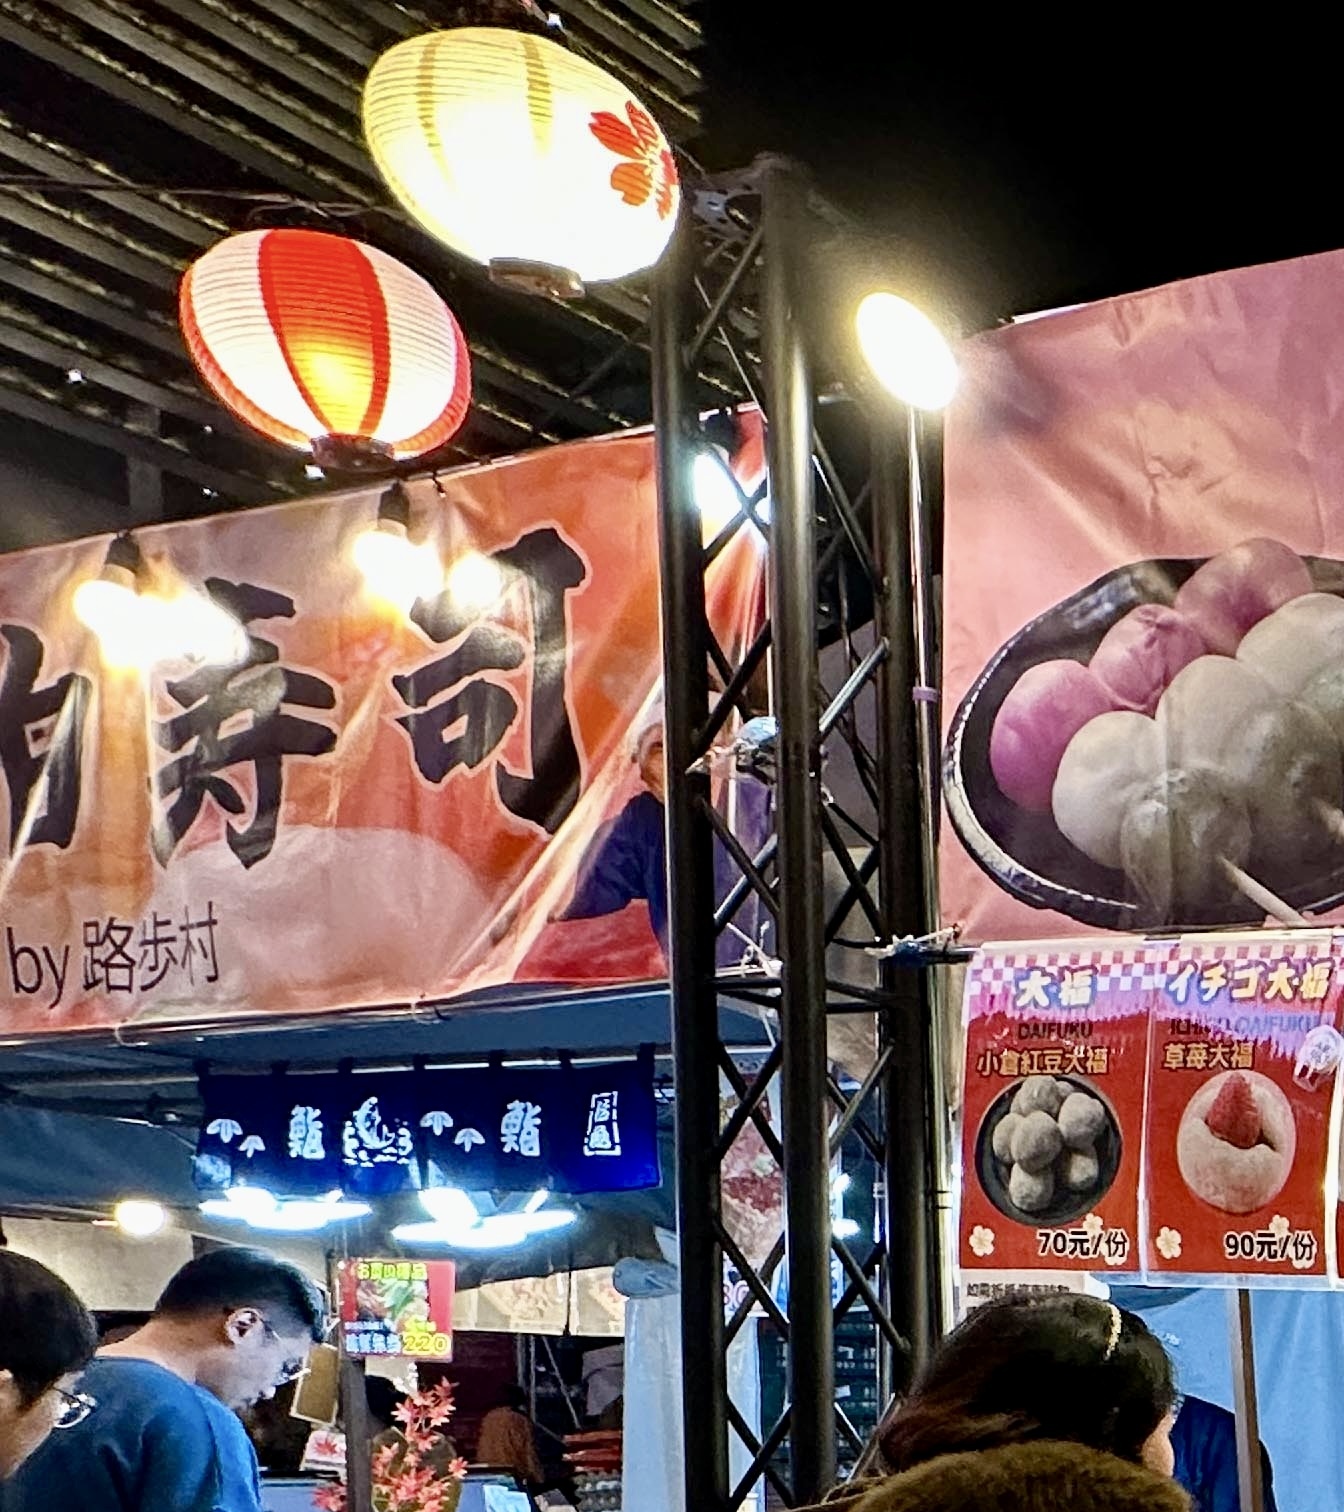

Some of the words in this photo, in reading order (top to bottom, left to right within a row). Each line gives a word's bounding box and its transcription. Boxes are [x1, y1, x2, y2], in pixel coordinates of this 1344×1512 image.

[0, 528, 588, 870] 寿司
[8, 928, 70, 1010] by
[1017, 1022, 1093, 1040] DAIFUKU
[1038, 1229, 1129, 1260] 70元/份
[1224, 1232, 1317, 1262] 90元/份
[403, 1333, 452, 1356] 220
